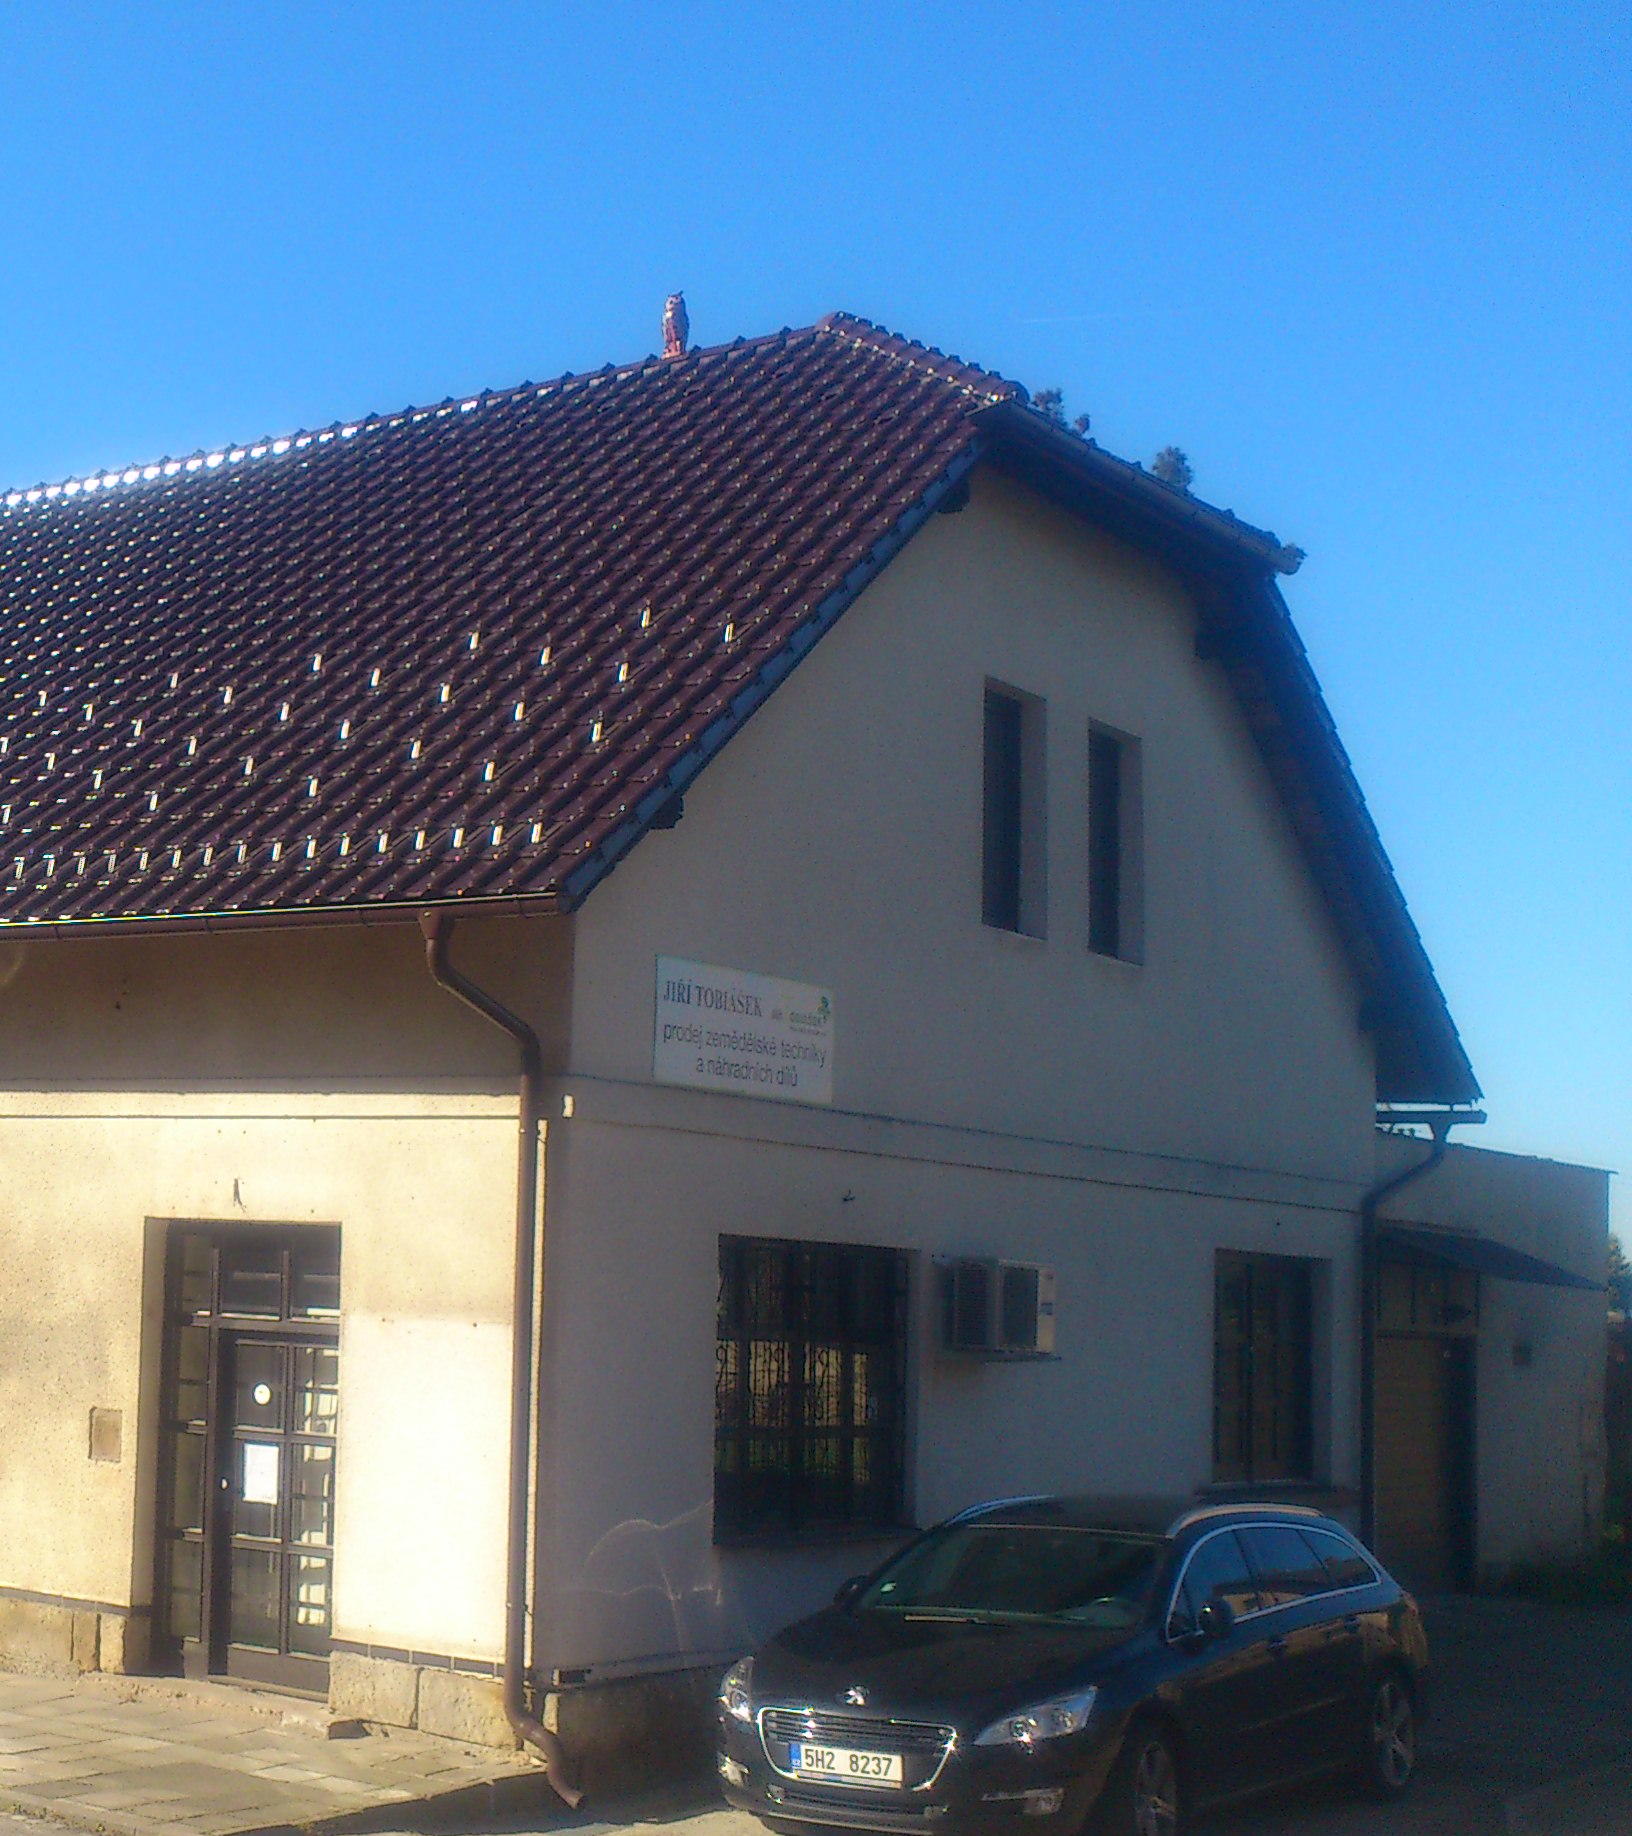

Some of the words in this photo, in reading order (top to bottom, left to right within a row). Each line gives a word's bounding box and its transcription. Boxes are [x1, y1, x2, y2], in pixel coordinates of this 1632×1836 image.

[663, 978, 692, 1005] JIŘÍ
[695, 986, 763, 1017] TOBIÁŠEK
[663, 1023, 703, 1050] prodej
[696, 1057, 704, 1073] a
[804, 1748, 836, 1771] 5H2
[848, 1753, 893, 1777] 8237
